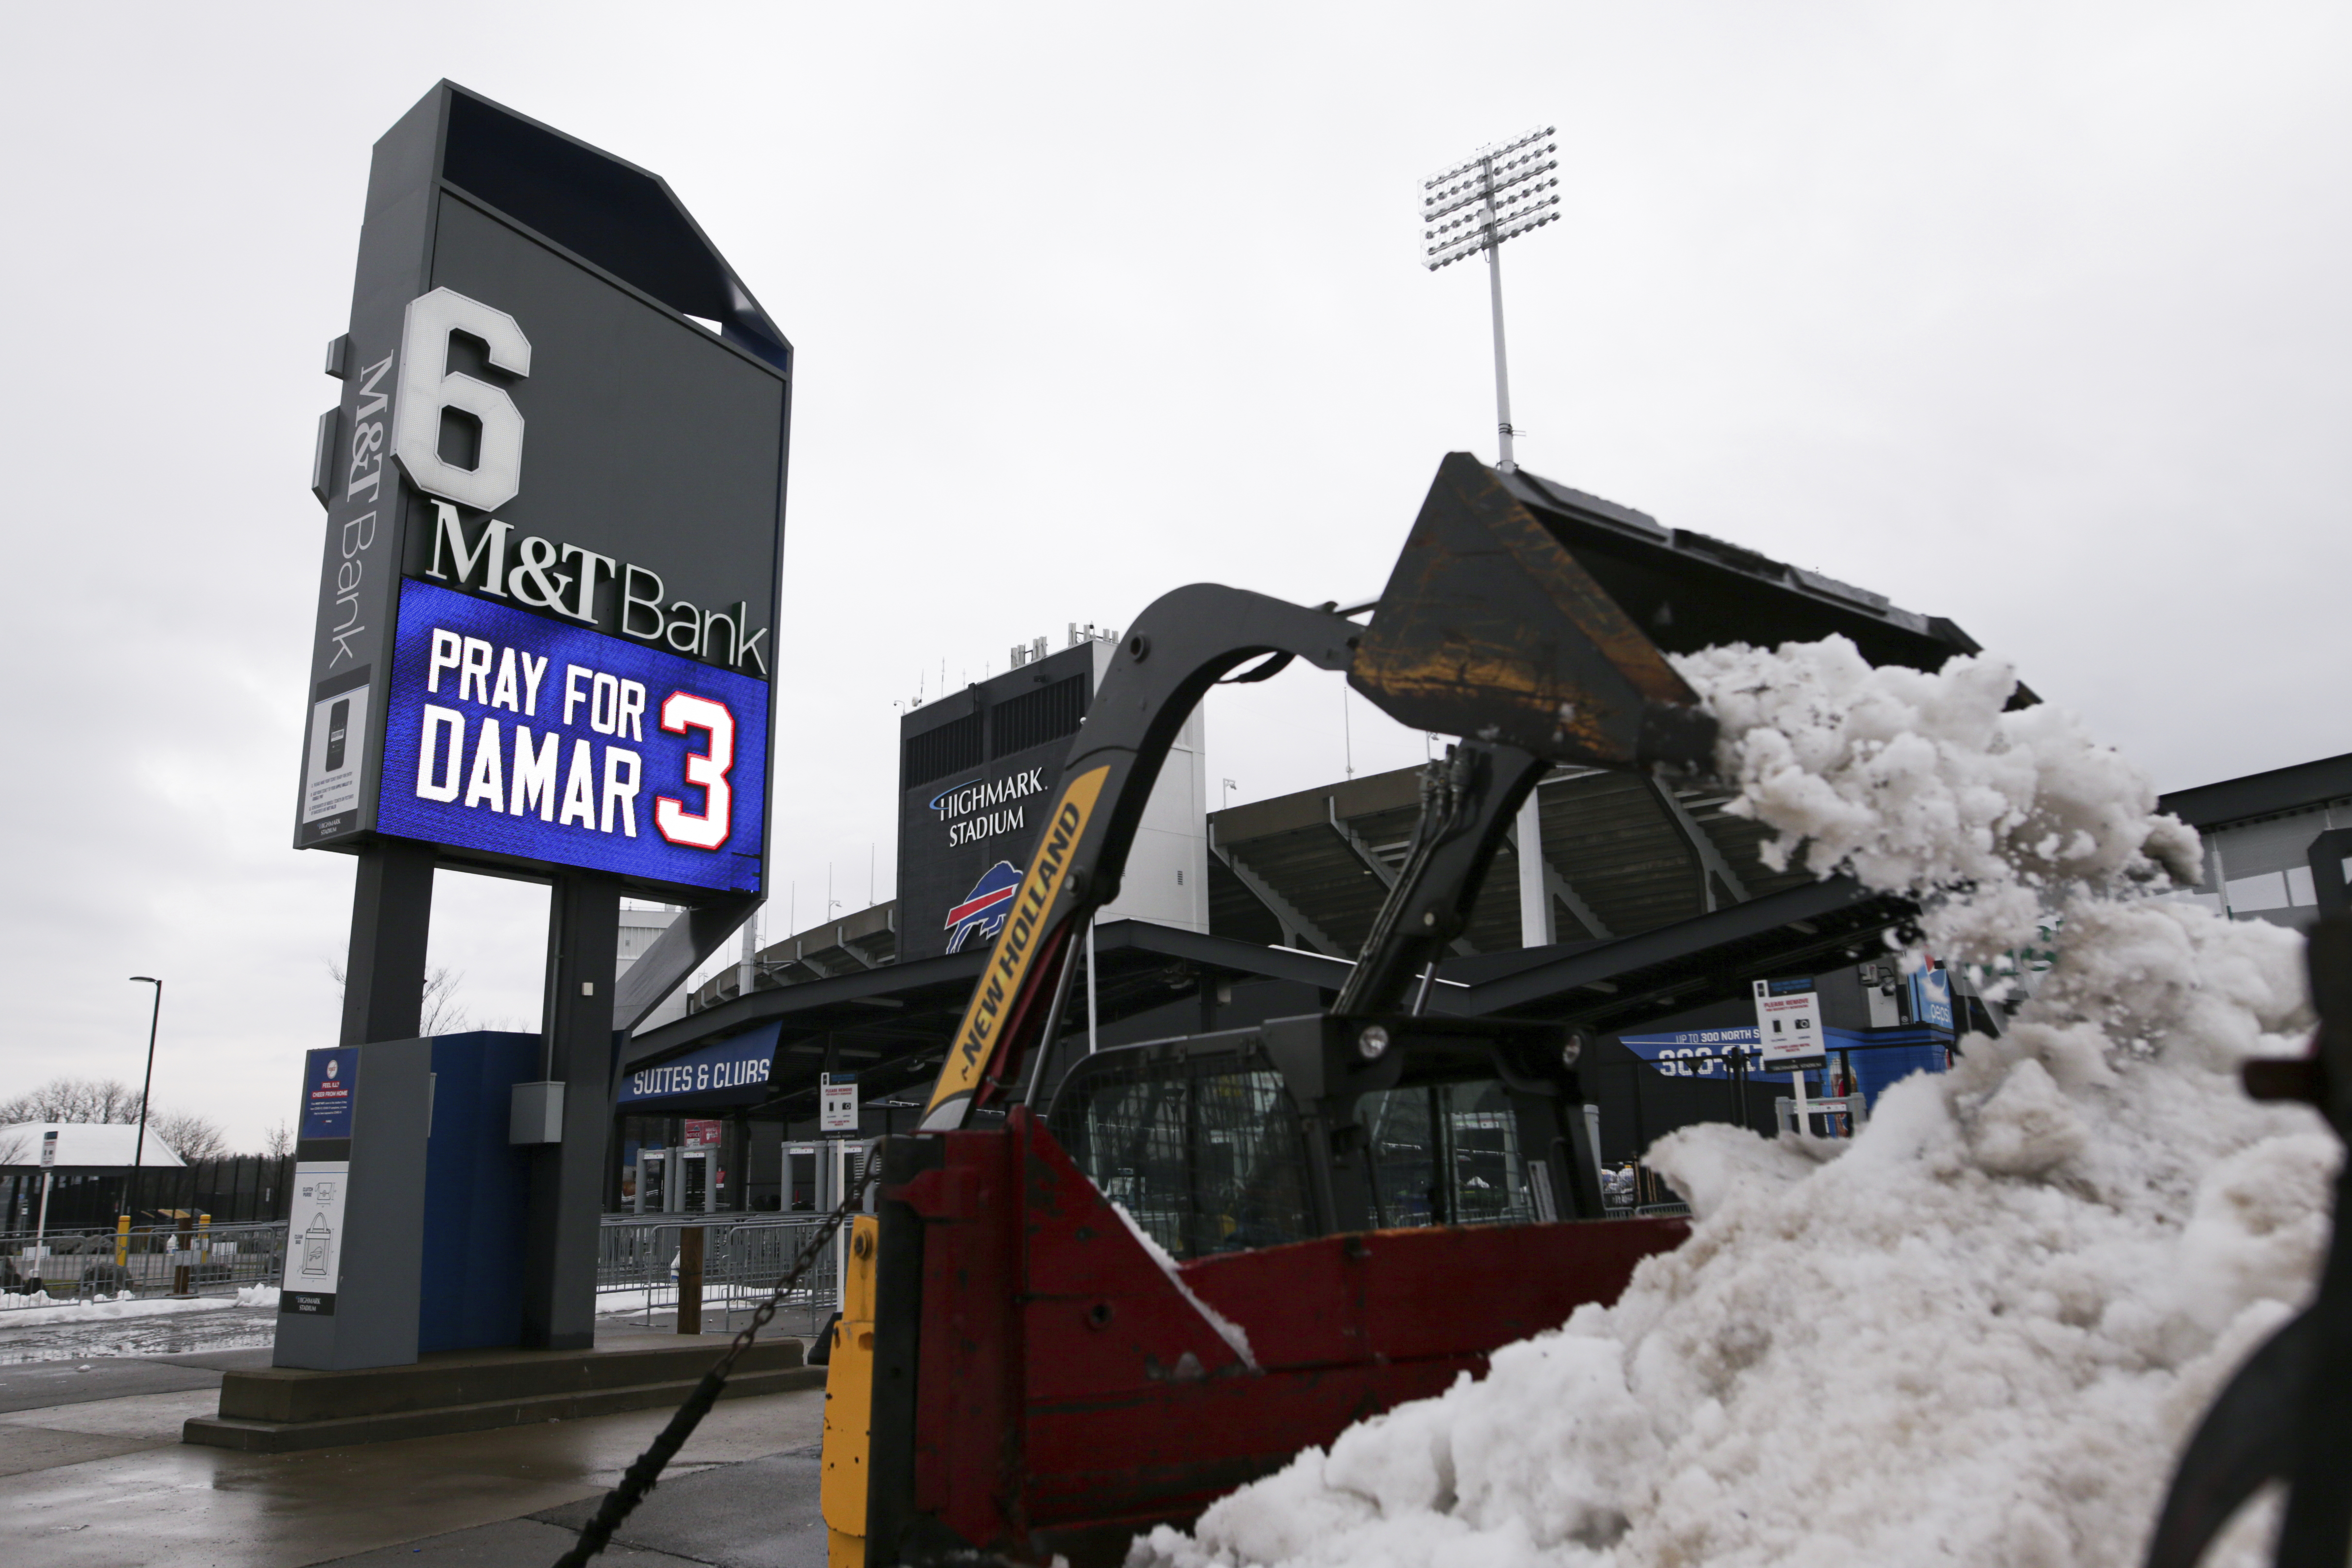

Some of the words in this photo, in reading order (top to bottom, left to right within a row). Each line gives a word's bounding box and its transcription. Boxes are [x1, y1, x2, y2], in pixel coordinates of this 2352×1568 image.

[346, 349, 394, 502] M&T
[390, 286, 531, 512] 6
[329, 510, 376, 669] Bank
[426, 498, 616, 624] M&T
[622, 563, 768, 675] Bank
[428, 628, 548, 716] PRAY
[563, 664, 645, 742] FOR
[321, 827, 337, 836] STADIUM
[416, 703, 642, 838] DAMAR
[654, 690, 735, 851] 3
[940, 767, 1043, 821] HIGHMARK
[949, 806, 1024, 847] STADIUM
[963, 976, 1005, 1067] NEW
[999, 802, 1080, 980] HOLLAND
[1676, 1034, 1687, 1043] UP
[1688, 1034, 1699, 1043] TO
[1701, 1032, 1719, 1042] 300
[1721, 1030, 1751, 1041] NORTH
[1931, 1004, 1951, 1025] pepsi
[634, 1066, 692, 1095] SUITES
[697, 1064, 709, 1089] &
[713, 1059, 770, 1088] CLUBS
